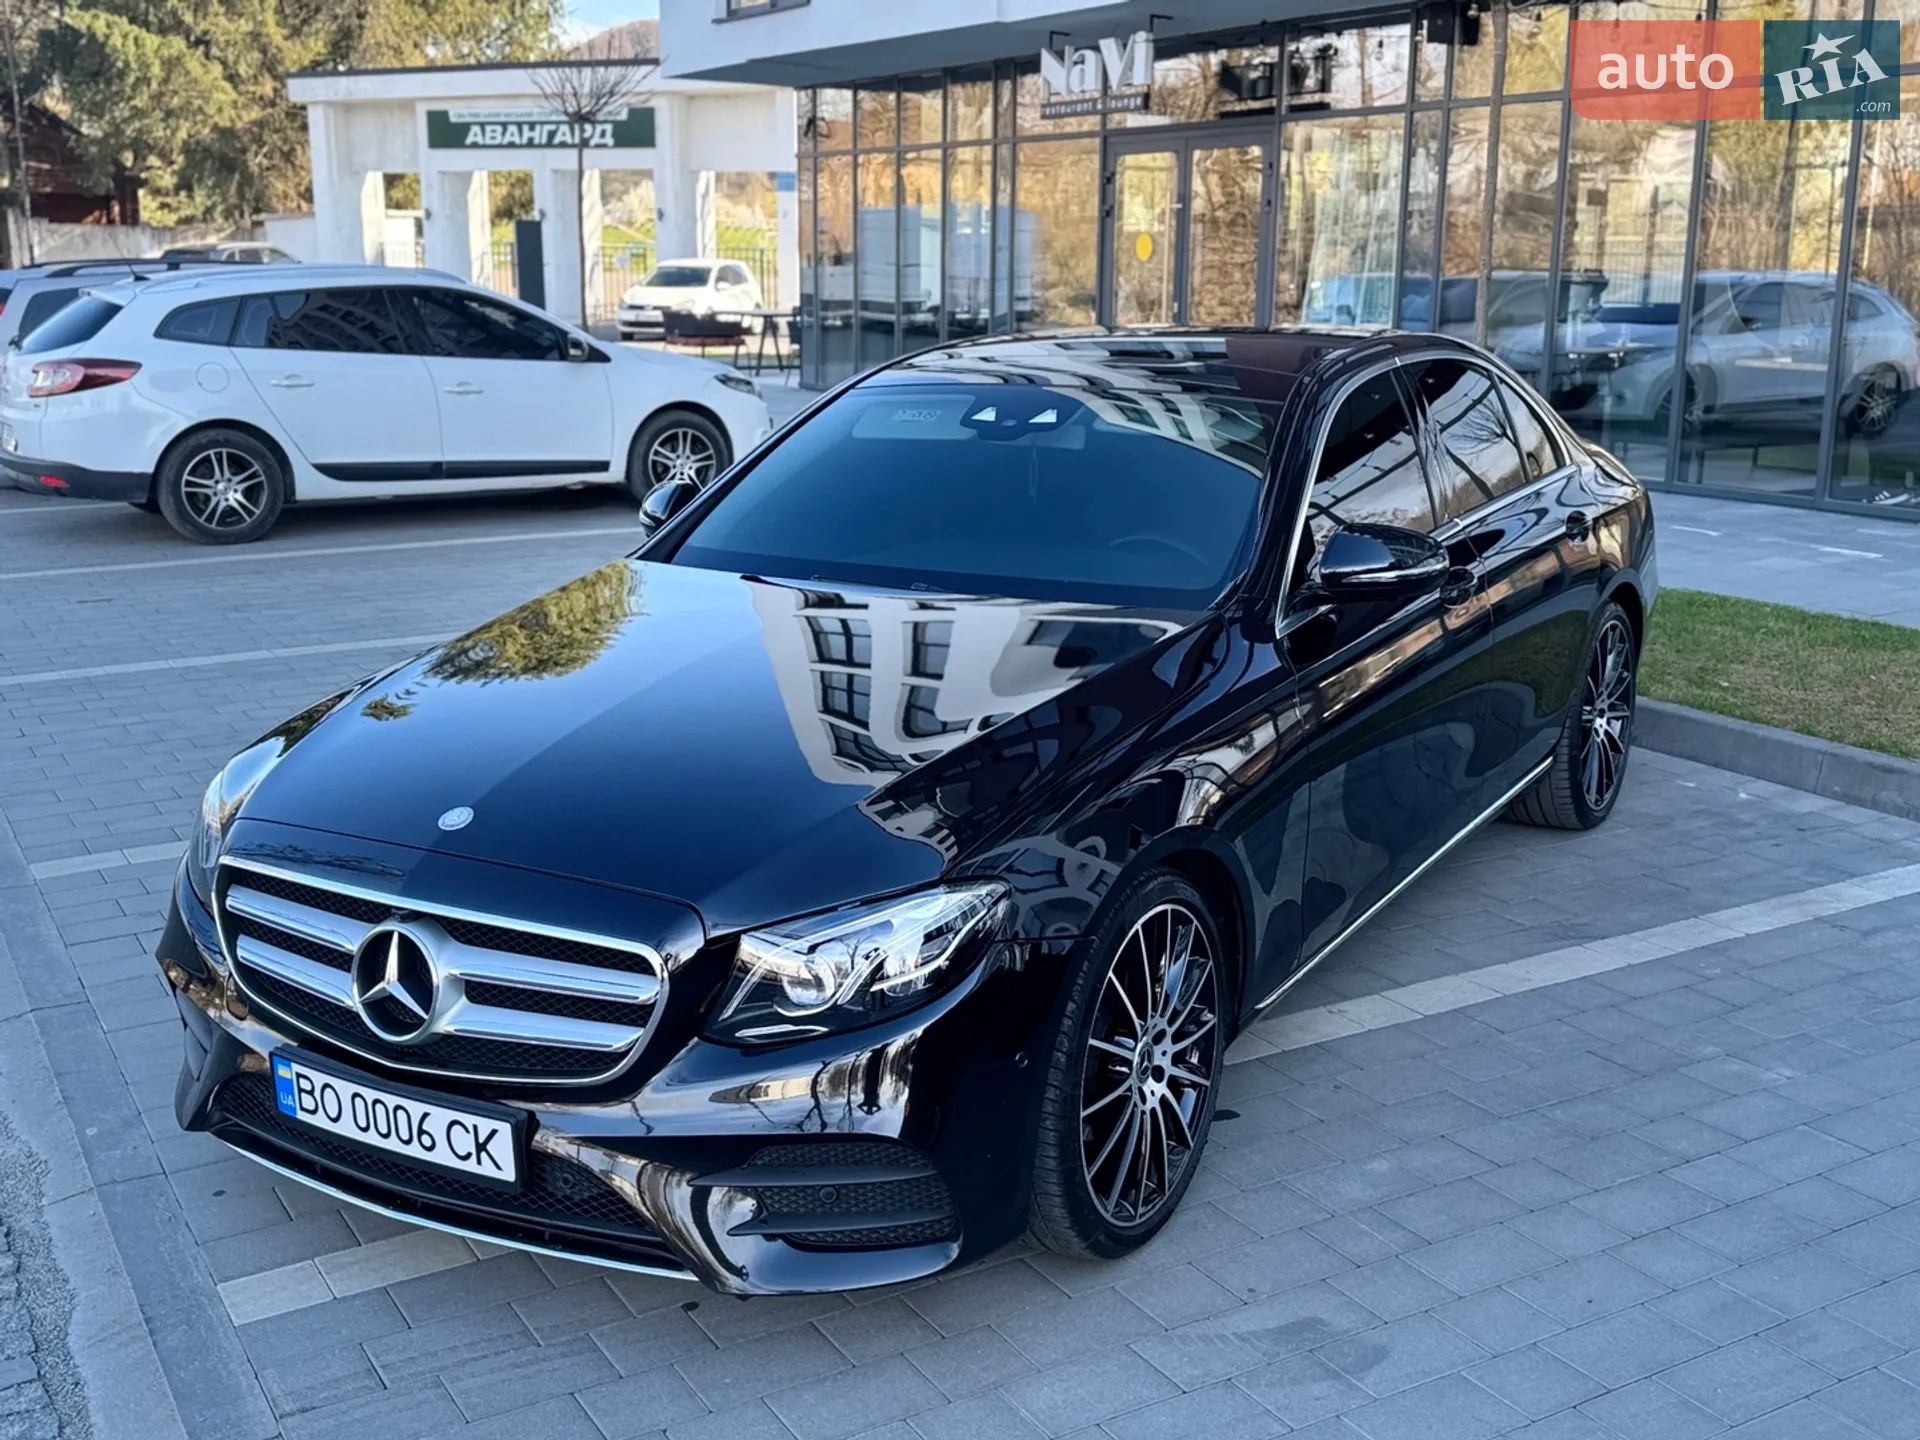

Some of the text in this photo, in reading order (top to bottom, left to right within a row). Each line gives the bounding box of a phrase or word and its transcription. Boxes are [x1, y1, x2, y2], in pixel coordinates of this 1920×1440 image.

[1041, 30, 1153, 103] NaVi
[464, 122, 615, 147] АВАНГАРД
[280, 1094, 295, 1107] UA
[295, 1071, 504, 1171] BO 0006 CK
